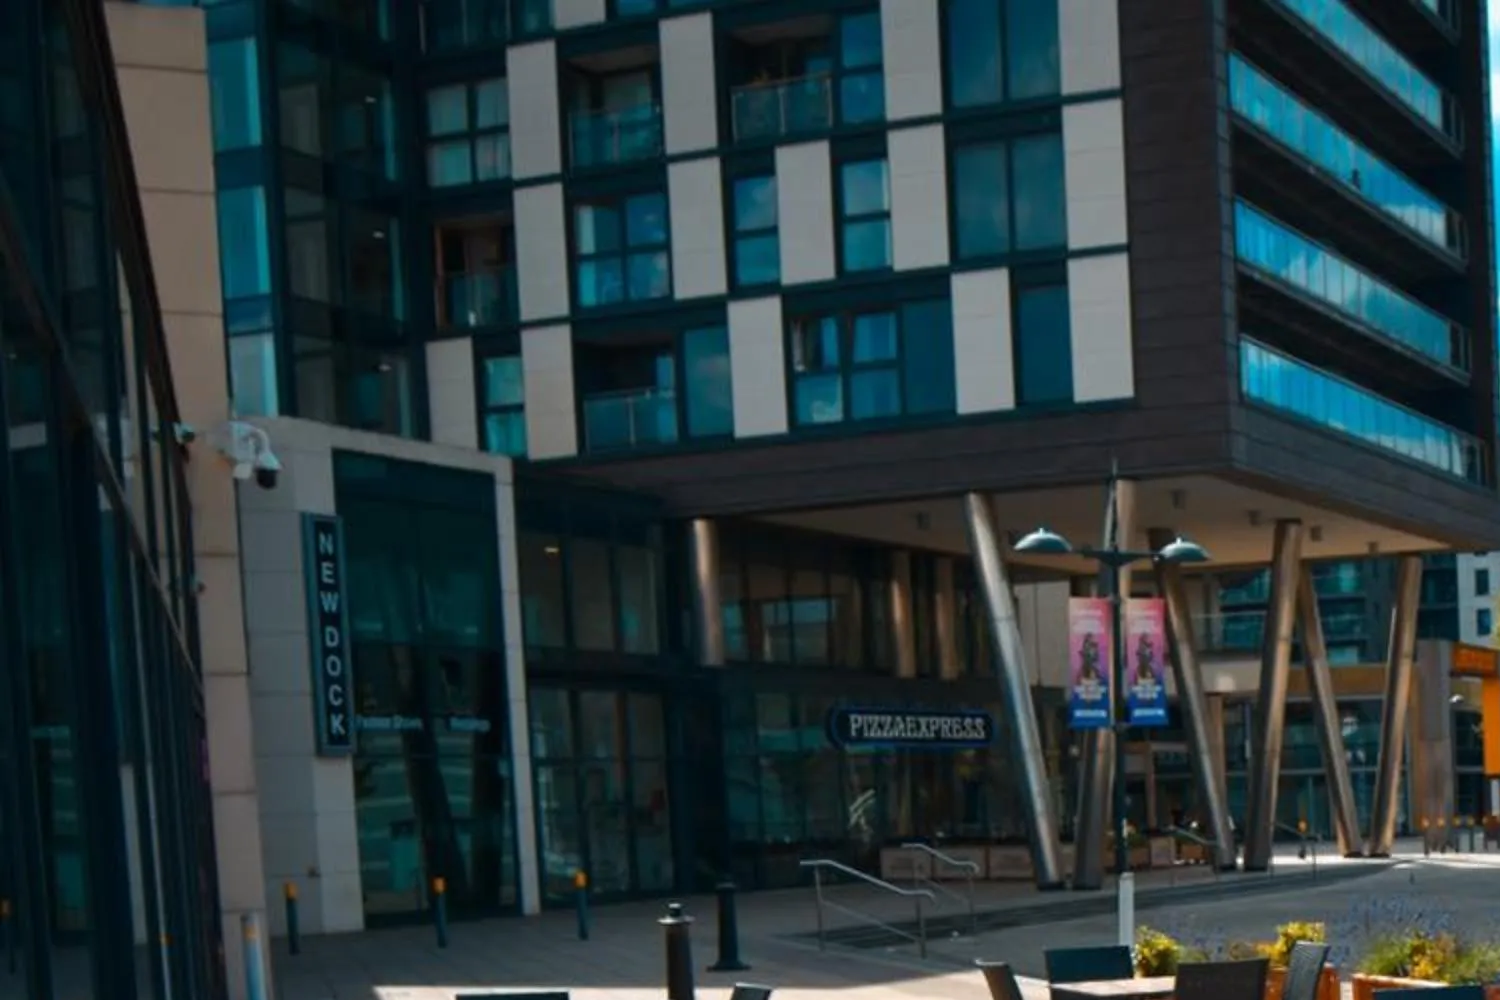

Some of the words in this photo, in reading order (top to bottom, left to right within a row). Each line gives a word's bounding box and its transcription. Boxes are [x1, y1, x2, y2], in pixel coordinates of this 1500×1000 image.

[318, 530, 339, 614] NEW
[324, 625, 346, 737] DOCK
[848, 713, 986, 740] PIZZAEXPRESS
